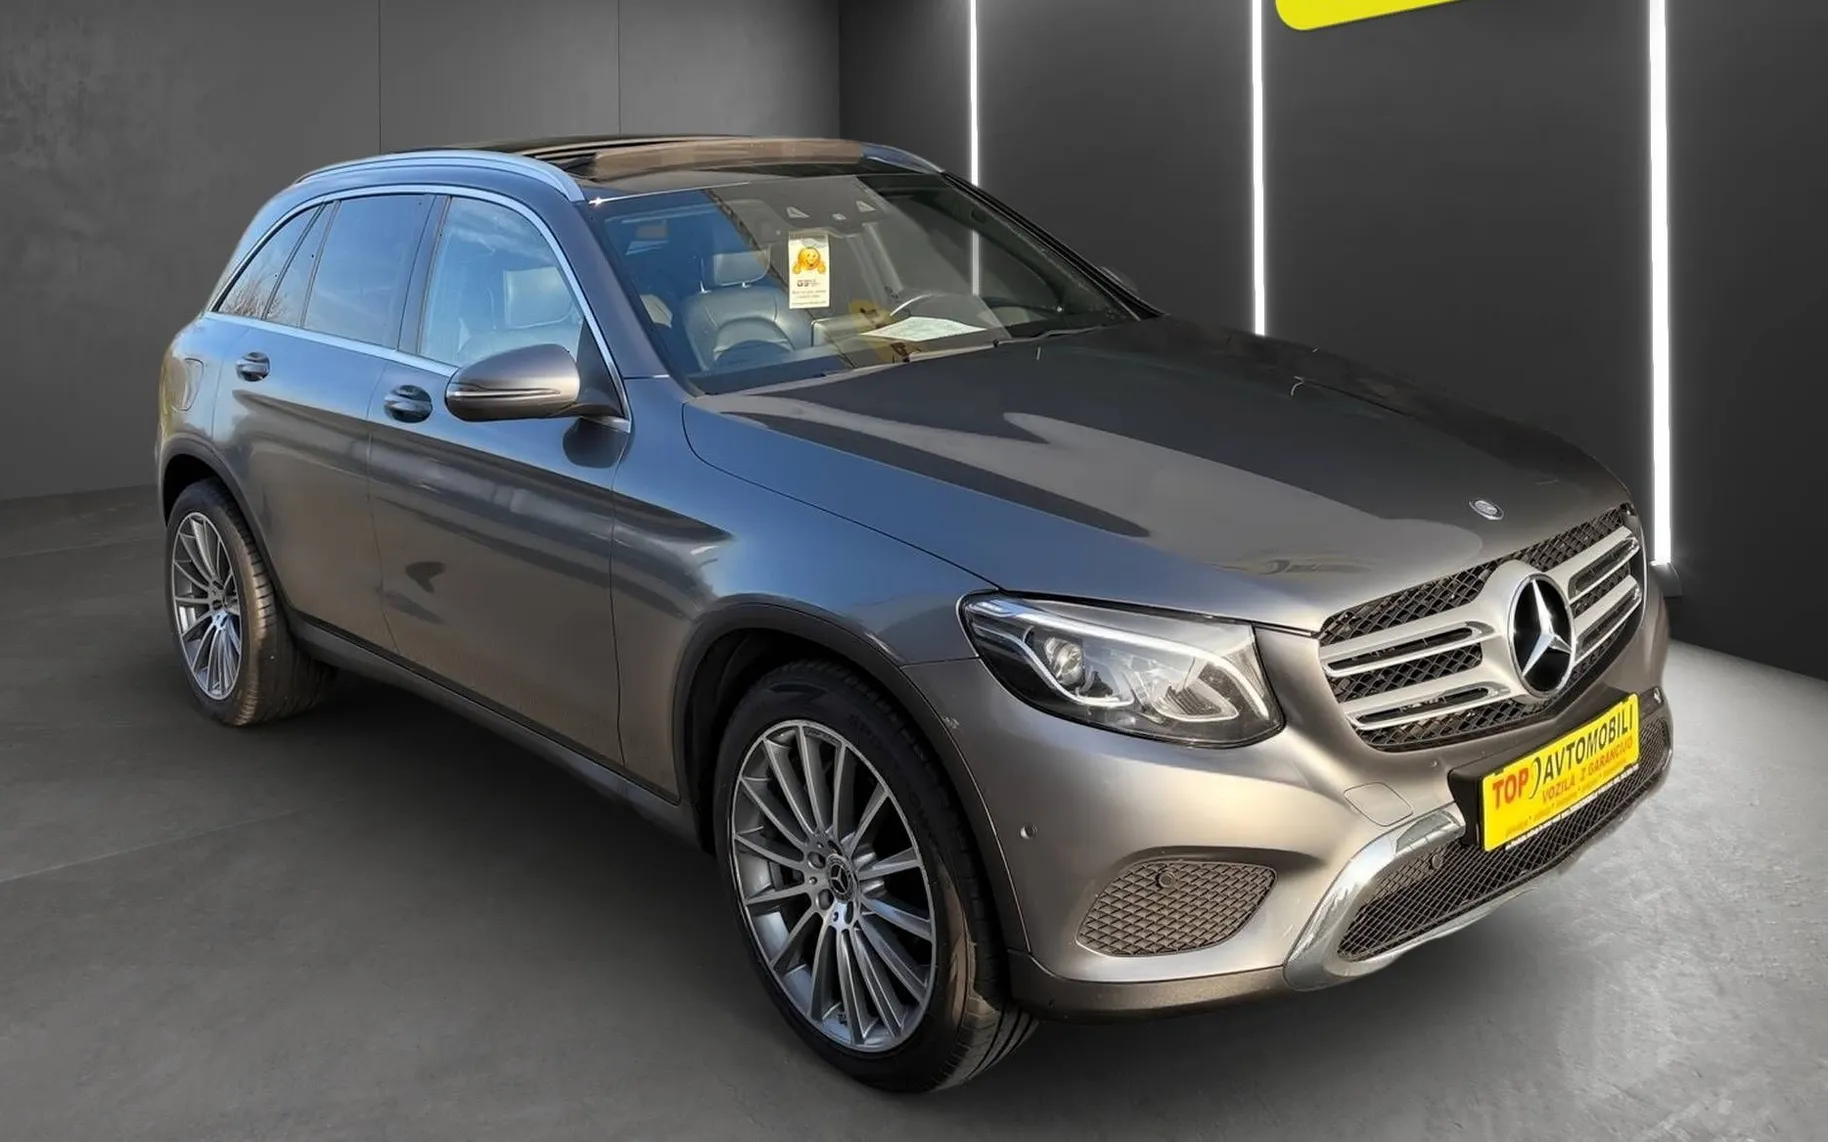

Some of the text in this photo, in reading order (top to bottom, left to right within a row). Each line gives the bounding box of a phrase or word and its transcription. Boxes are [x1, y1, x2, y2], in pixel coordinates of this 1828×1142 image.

[1492, 766, 1529, 810] TOP
[1542, 703, 1634, 786] AVTOMOBILI
[1542, 776, 1576, 803] VOZILA
